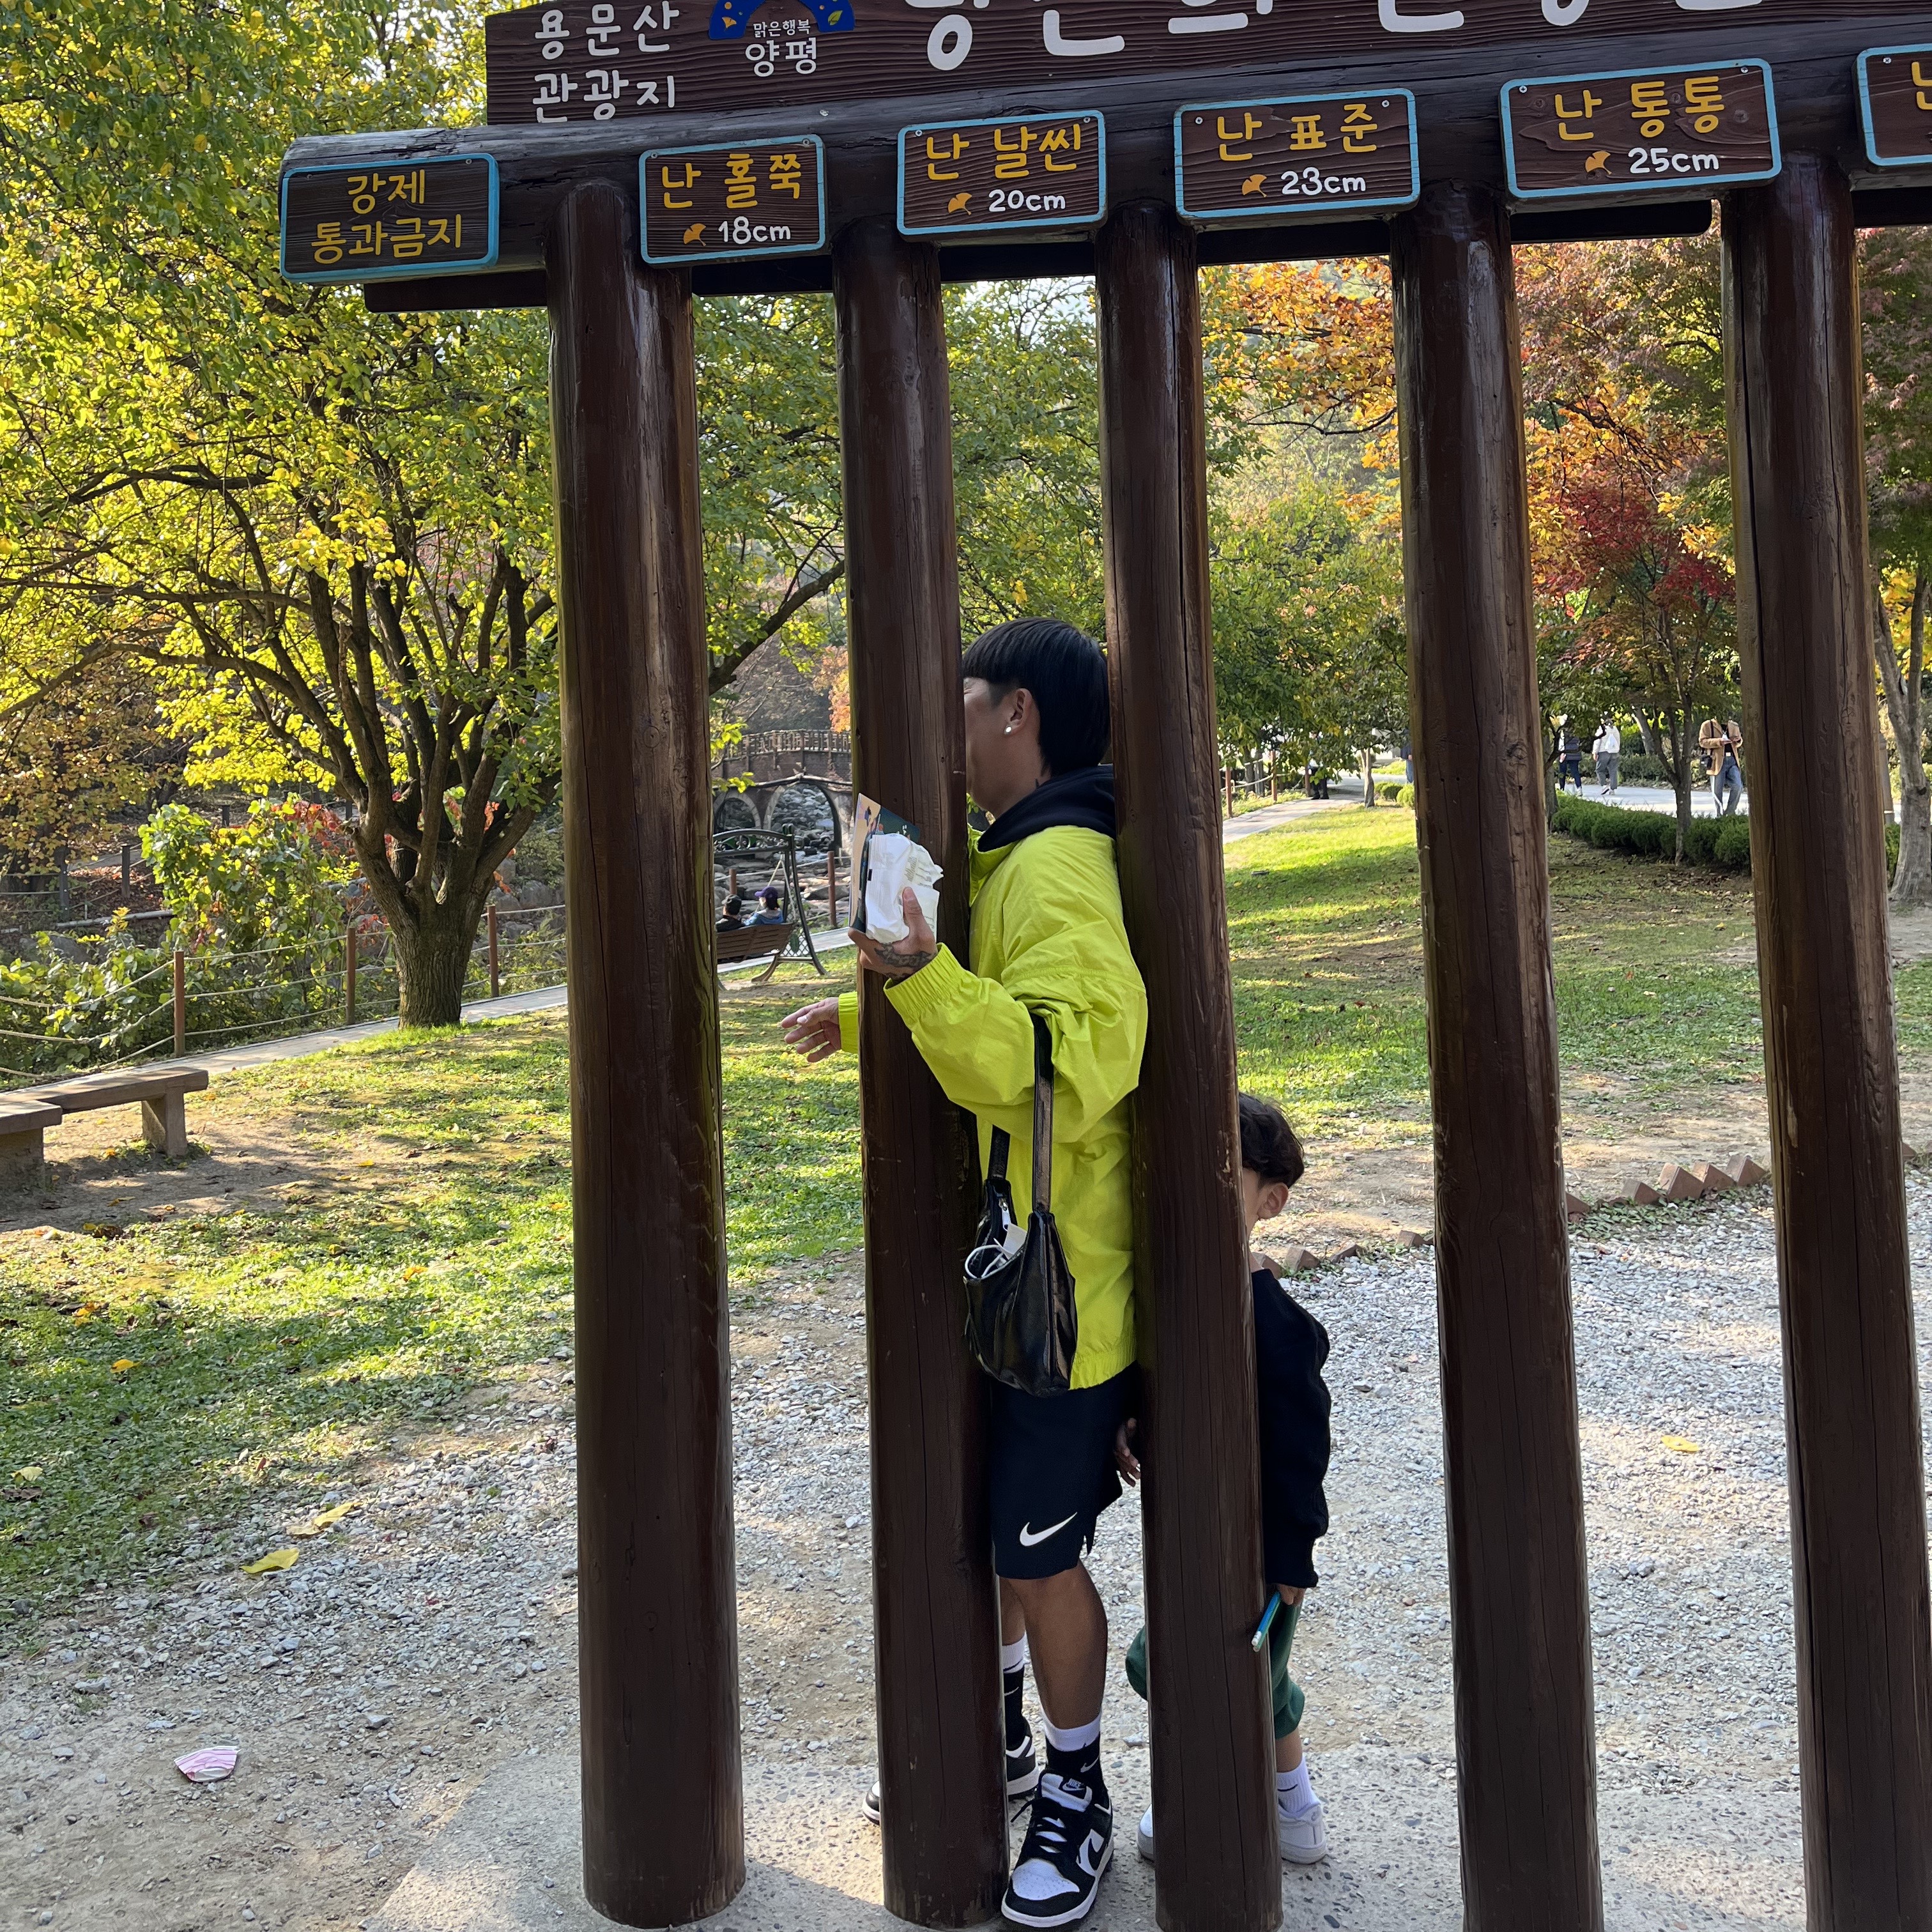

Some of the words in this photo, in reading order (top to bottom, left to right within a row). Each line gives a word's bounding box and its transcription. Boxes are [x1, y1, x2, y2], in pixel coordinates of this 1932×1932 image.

[535, 1, 679, 59] 용문산
[753, 19, 810, 38] 맑은행복
[745, 37, 816, 77] 양평
[532, 70, 675, 123] 관광지
[1555, 90, 1602, 141] 난
[1631, 75, 1725, 137] 통통
[926, 133, 969, 180] 난
[993, 123, 1081, 178] 날씬
[1218, 112, 1262, 162] 난
[1290, 103, 1377, 152] 표준
[662, 162, 702, 209] 난
[724, 153, 801, 209] 홀쭉
[1281, 166, 1366, 195] 23cm
[1627, 147, 1719, 174] 25cm
[347, 169, 426, 215] 강제
[988, 189, 1066, 213] 20cm
[311, 214, 462, 264] 통과금지
[718, 217, 792, 245] 18cm
